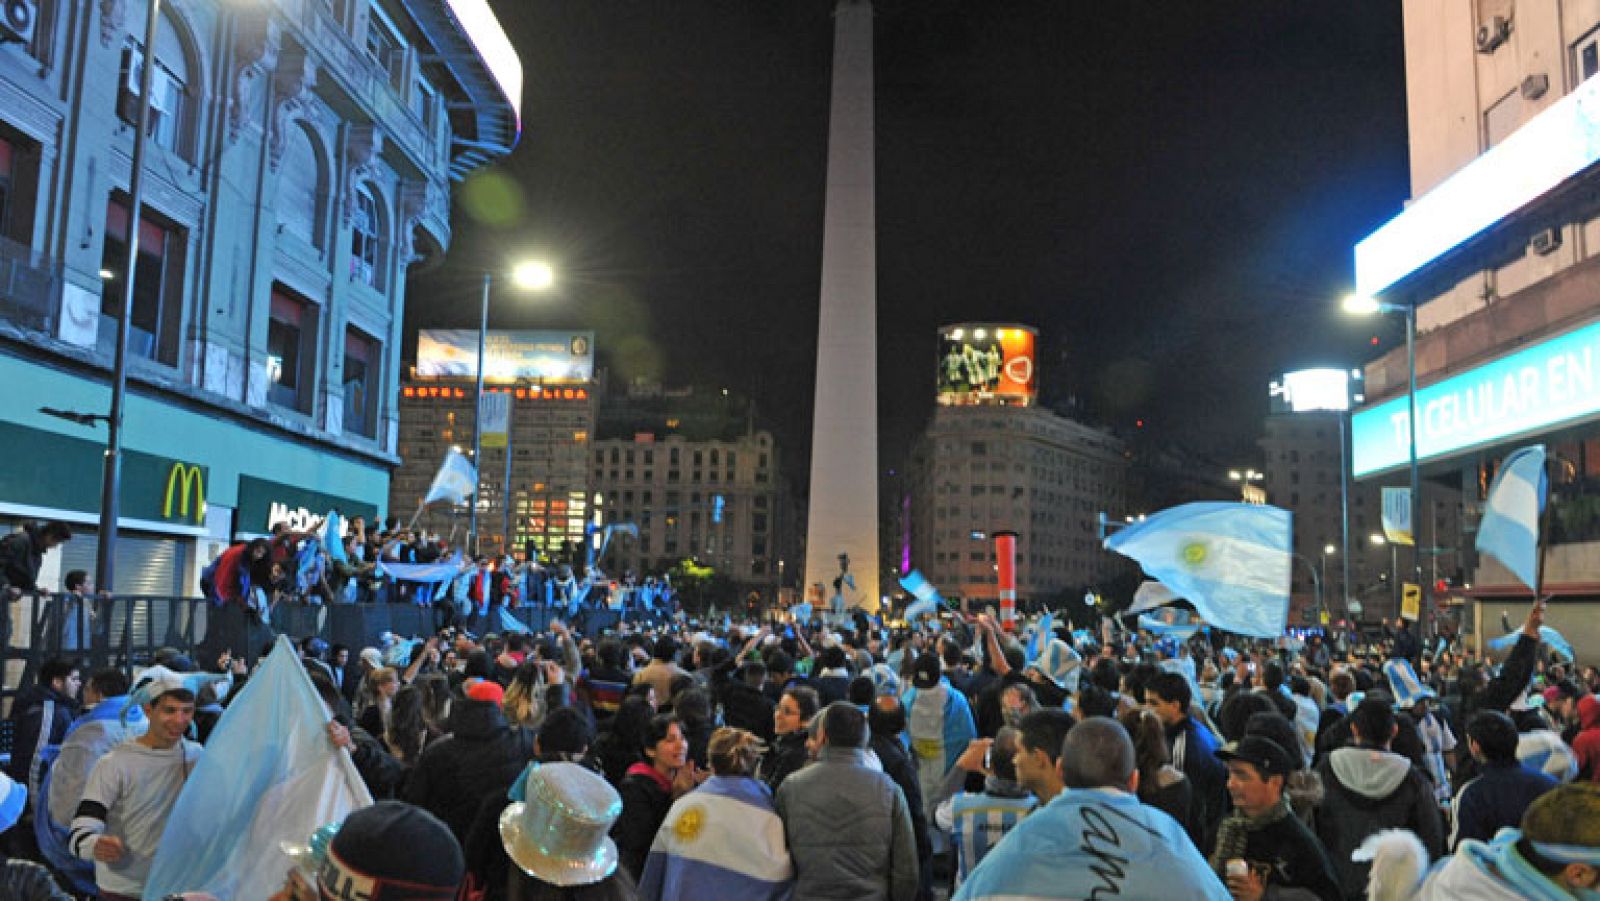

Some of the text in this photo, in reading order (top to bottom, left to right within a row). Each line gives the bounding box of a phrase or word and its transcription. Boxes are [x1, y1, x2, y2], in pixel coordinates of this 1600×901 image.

[481, 386, 588, 400] UBLICA
[1423, 364, 1541, 440] CELULAR
[1545, 345, 1597, 402] EN
